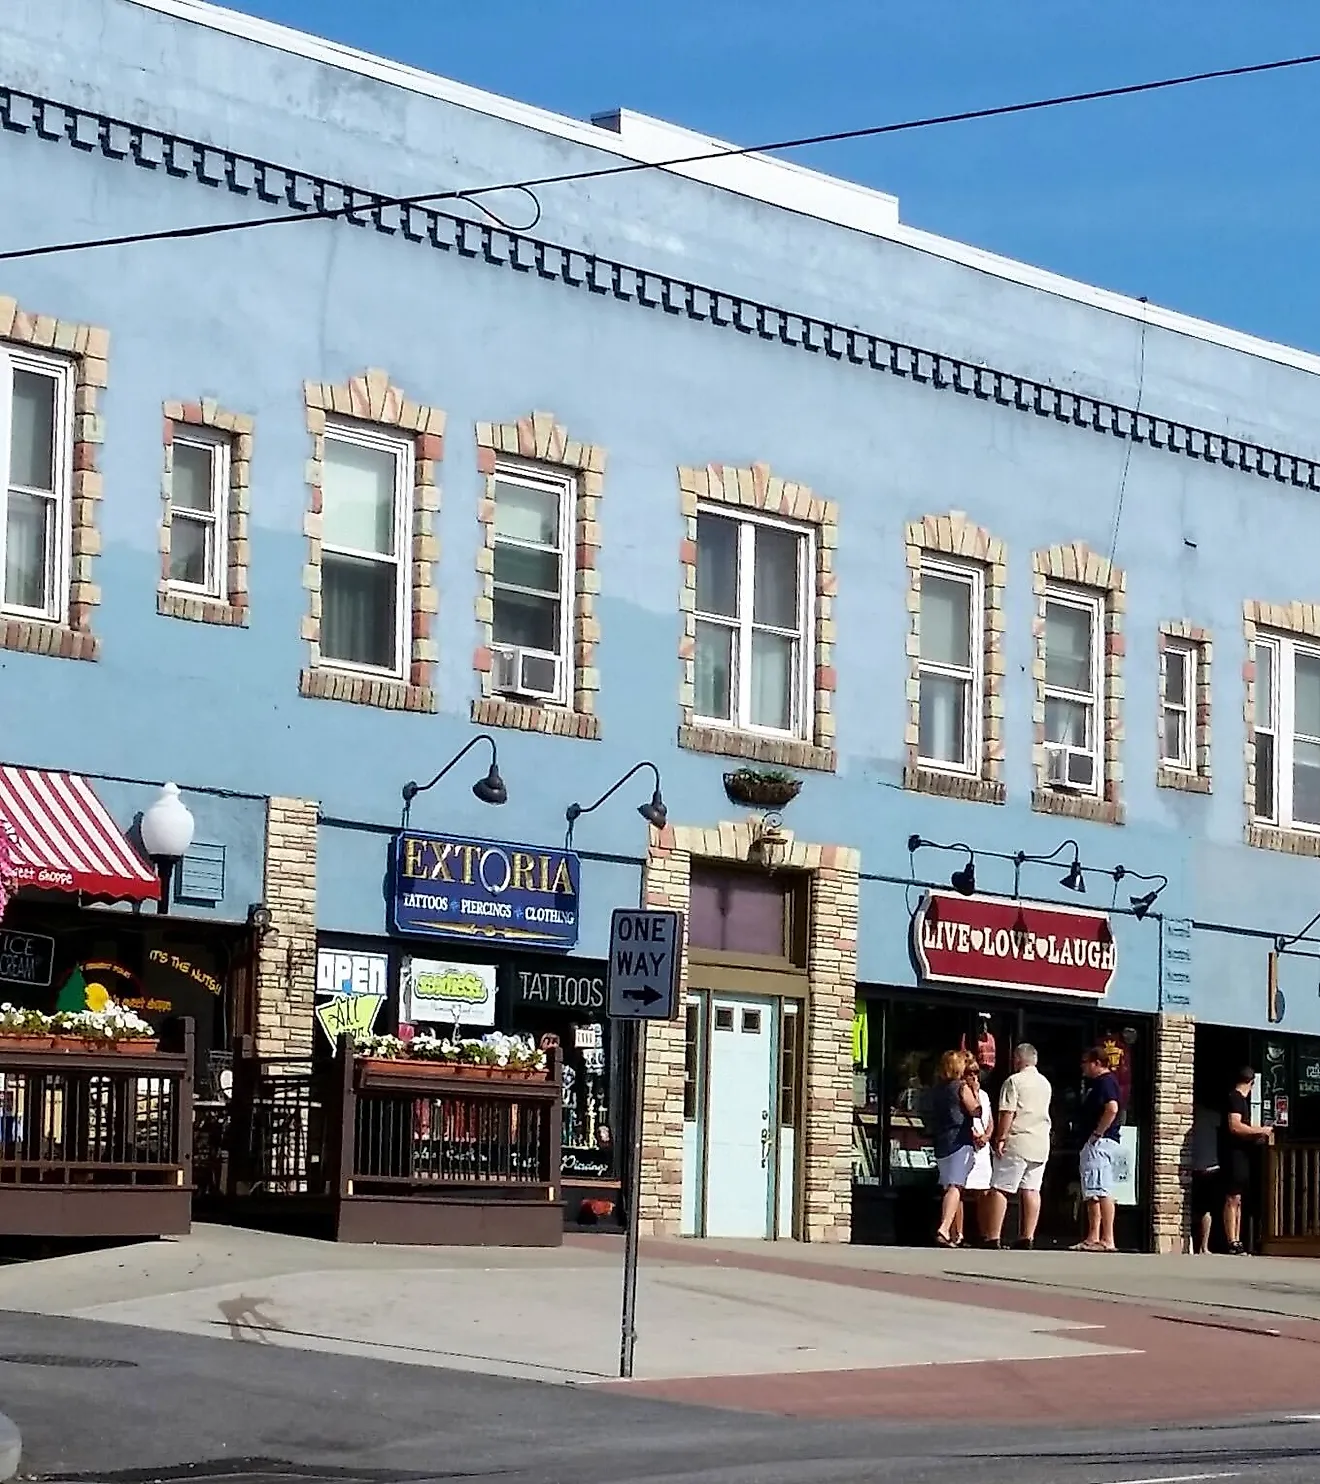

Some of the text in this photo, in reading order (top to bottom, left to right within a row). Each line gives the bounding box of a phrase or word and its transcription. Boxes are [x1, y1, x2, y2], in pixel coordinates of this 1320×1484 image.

[402, 838, 575, 896] EXTORIA
[402, 893, 575, 926] TATTOOS PIERCINGS CLOTHING
[618, 916, 666, 943] ONE
[924, 919, 1116, 971] LIVE LOVE LAUGH
[3, 937, 34, 956] ICE
[170, 955, 192, 974] THE
[317, 953, 387, 994] OPEN
[617, 951, 666, 977] WAY
[519, 971, 604, 1008] TATTOOS
